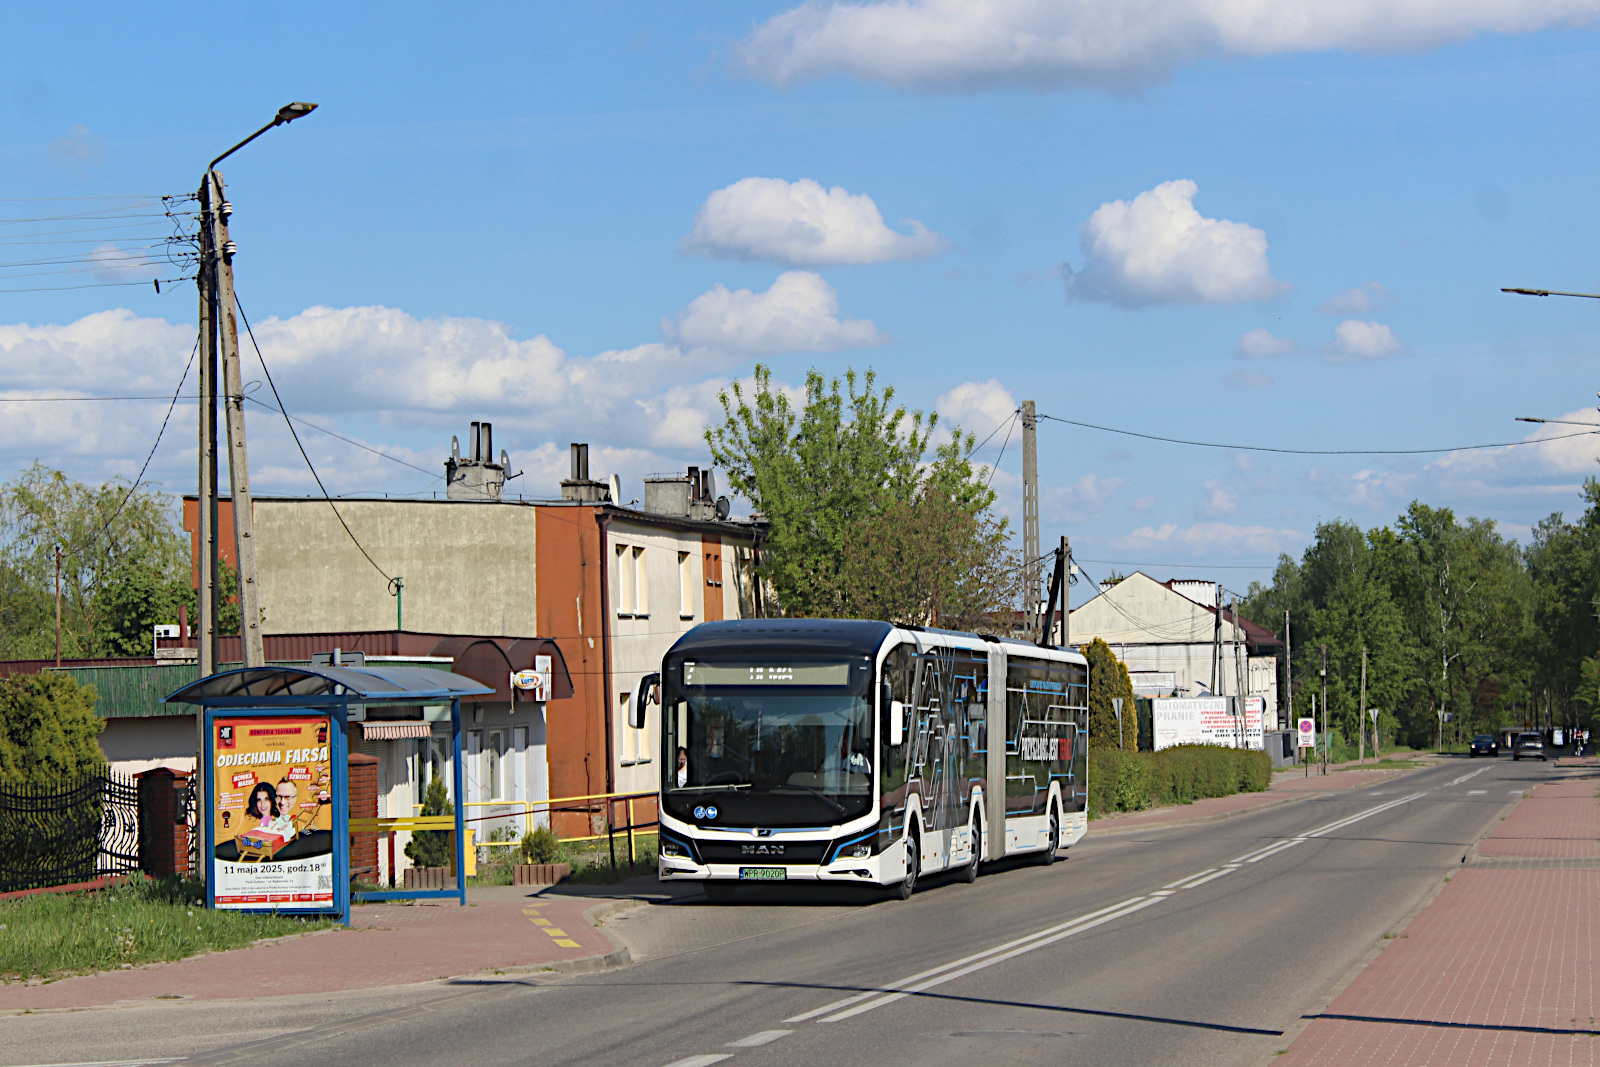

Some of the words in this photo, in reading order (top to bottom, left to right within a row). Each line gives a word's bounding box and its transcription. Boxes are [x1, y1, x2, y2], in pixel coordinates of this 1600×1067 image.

[1156, 700, 1225, 710] AUTOMATYCZNE
[1156, 712, 1195, 720] PRANIE
[217, 750, 282, 768] ODJECHANA
[285, 746, 328, 764] FARSA
[741, 844, 784, 854] MAN
[224, 866, 234, 874] 11
[237, 866, 258, 875] maja
[260, 864, 285, 874] 2025,
[744, 869, 758, 878] WPR
[761, 869, 785, 878] 9020P
